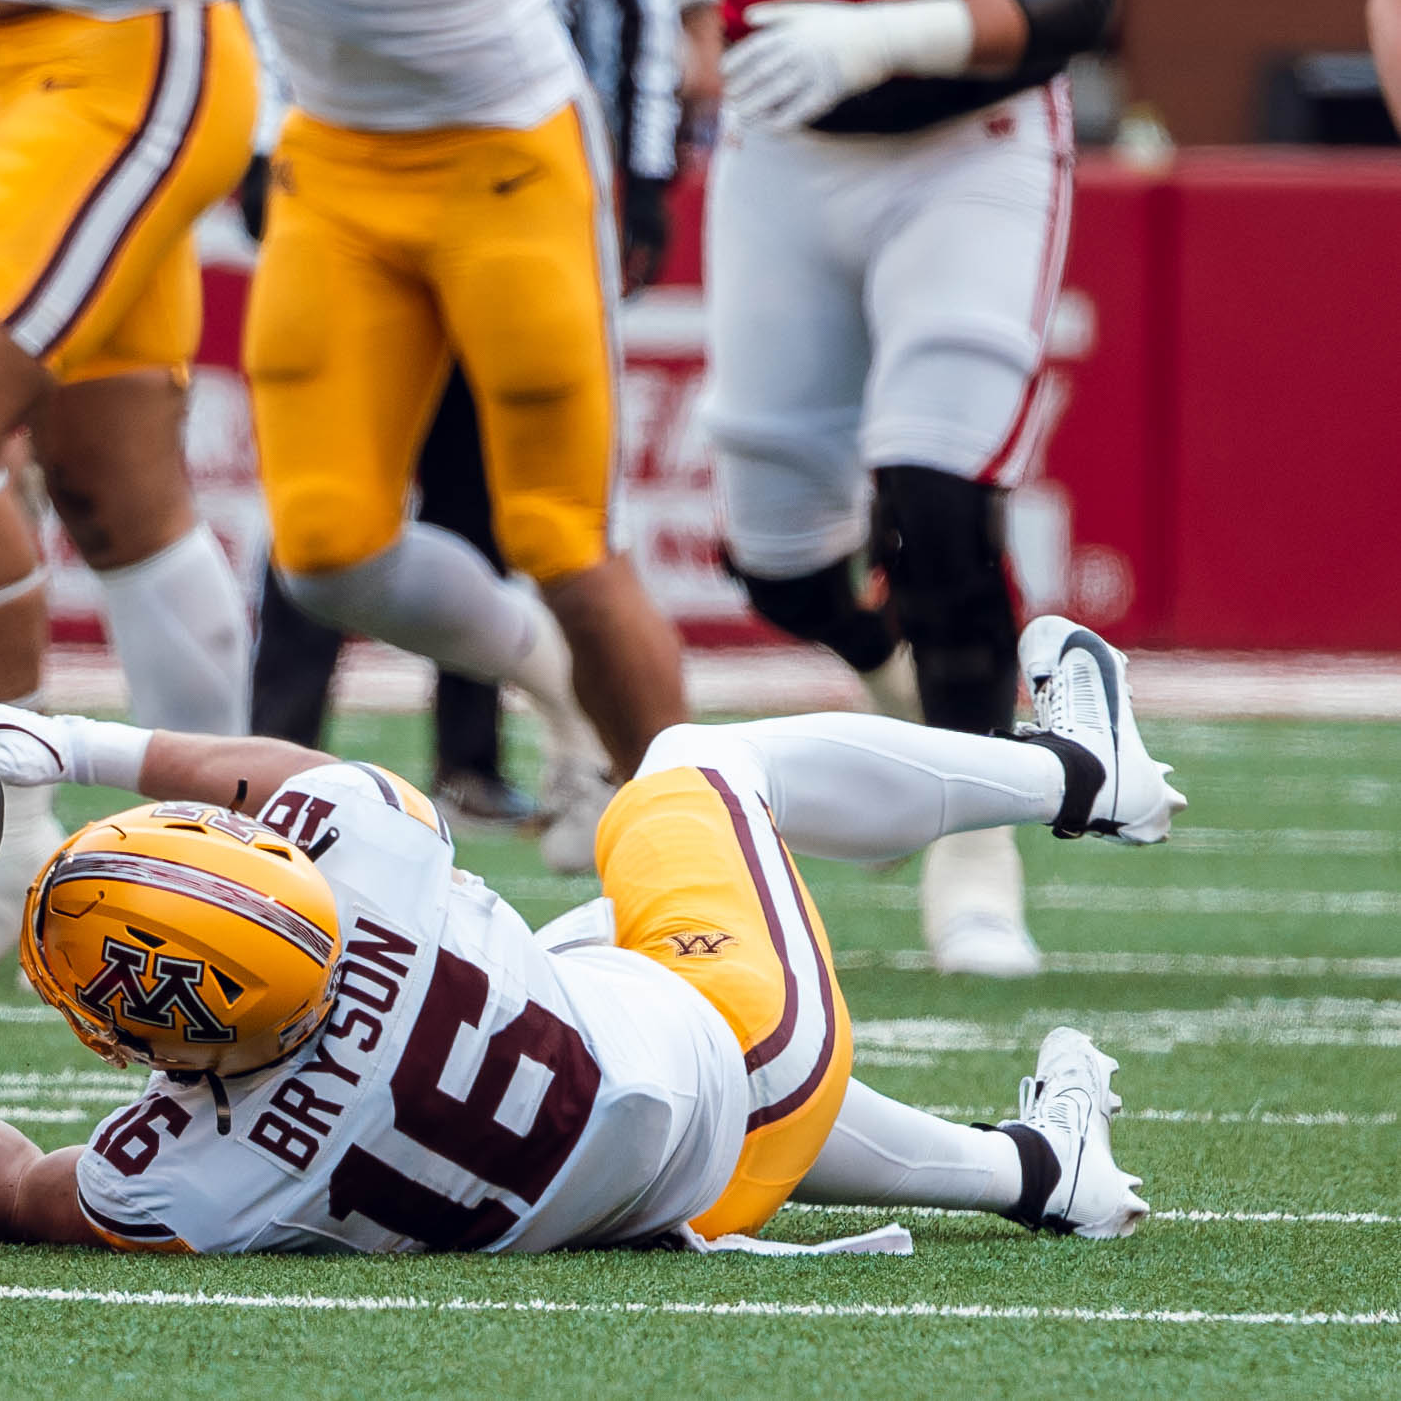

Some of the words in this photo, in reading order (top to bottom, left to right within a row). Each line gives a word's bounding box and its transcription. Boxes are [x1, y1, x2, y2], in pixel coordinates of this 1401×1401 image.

[74, 935, 238, 1044] M
[247, 917, 419, 1173] BRYSON
[92, 1092, 193, 1177] 16
[328, 945, 602, 1253] 16
